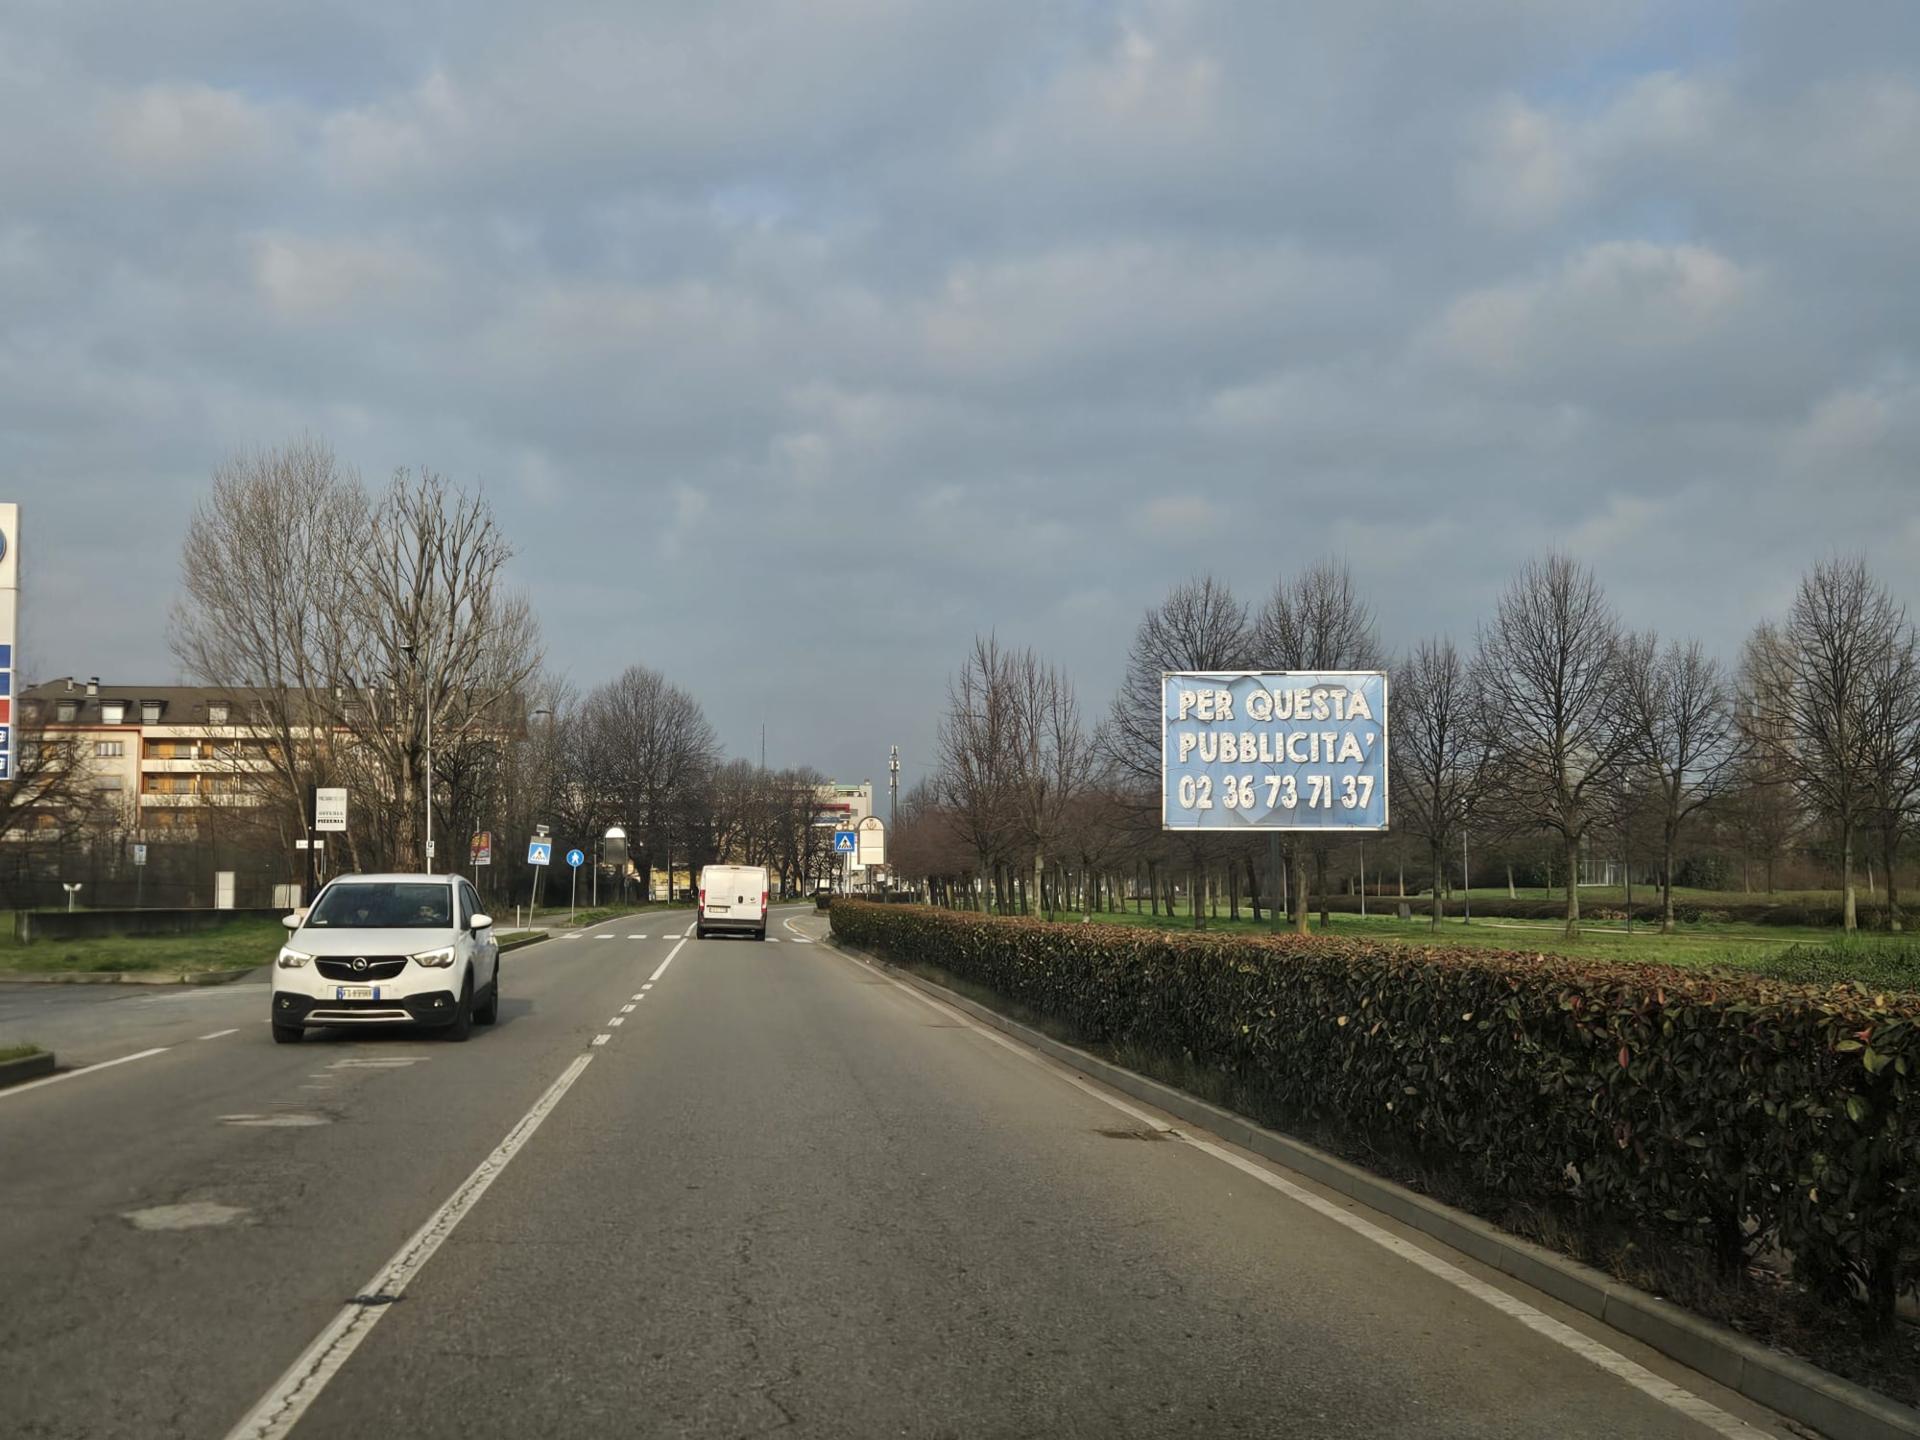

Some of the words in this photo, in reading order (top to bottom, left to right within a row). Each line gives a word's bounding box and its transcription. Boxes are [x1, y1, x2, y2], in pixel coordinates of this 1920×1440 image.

[1179, 689, 1234, 720] PER
[1246, 689, 1372, 721] QUESTA
[1179, 731, 1375, 763] PUBBLICITA'
[1178, 775, 1213, 809] 02
[1222, 775, 1255, 809] 36
[1264, 775, 1298, 809] 73
[1307, 775, 1332, 809] 71
[1341, 775, 1375, 809] 37
